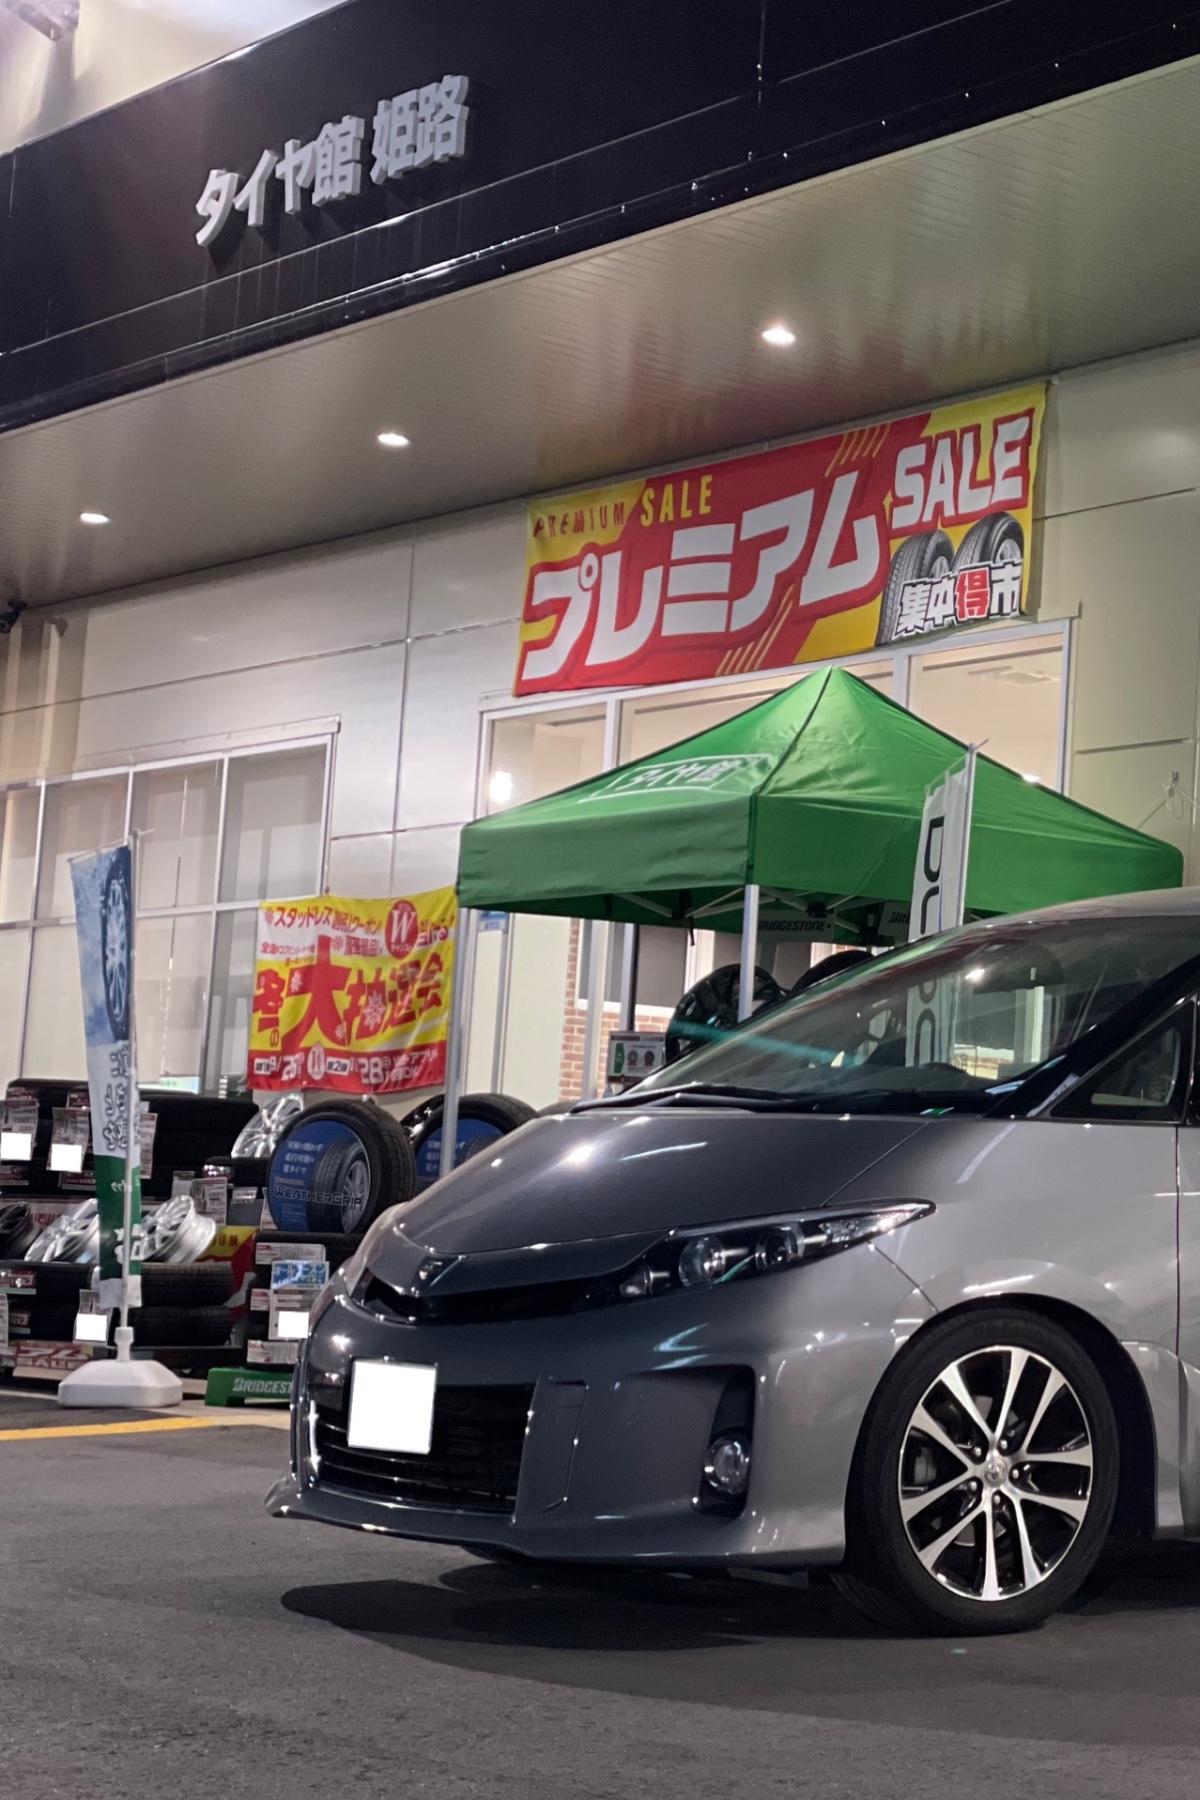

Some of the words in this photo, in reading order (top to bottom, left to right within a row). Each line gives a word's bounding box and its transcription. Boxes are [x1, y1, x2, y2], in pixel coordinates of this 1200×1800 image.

[195, 115, 365, 247] タイヤ館
[370, 74, 469, 185] 姫路
[533, 502, 626, 537] PREMIUM
[639, 475, 713, 526] SALE
[891, 416, 1031, 529] SALE
[522, 471, 881, 681] プレミアム
[896, 563, 1021, 634] 集中得市
